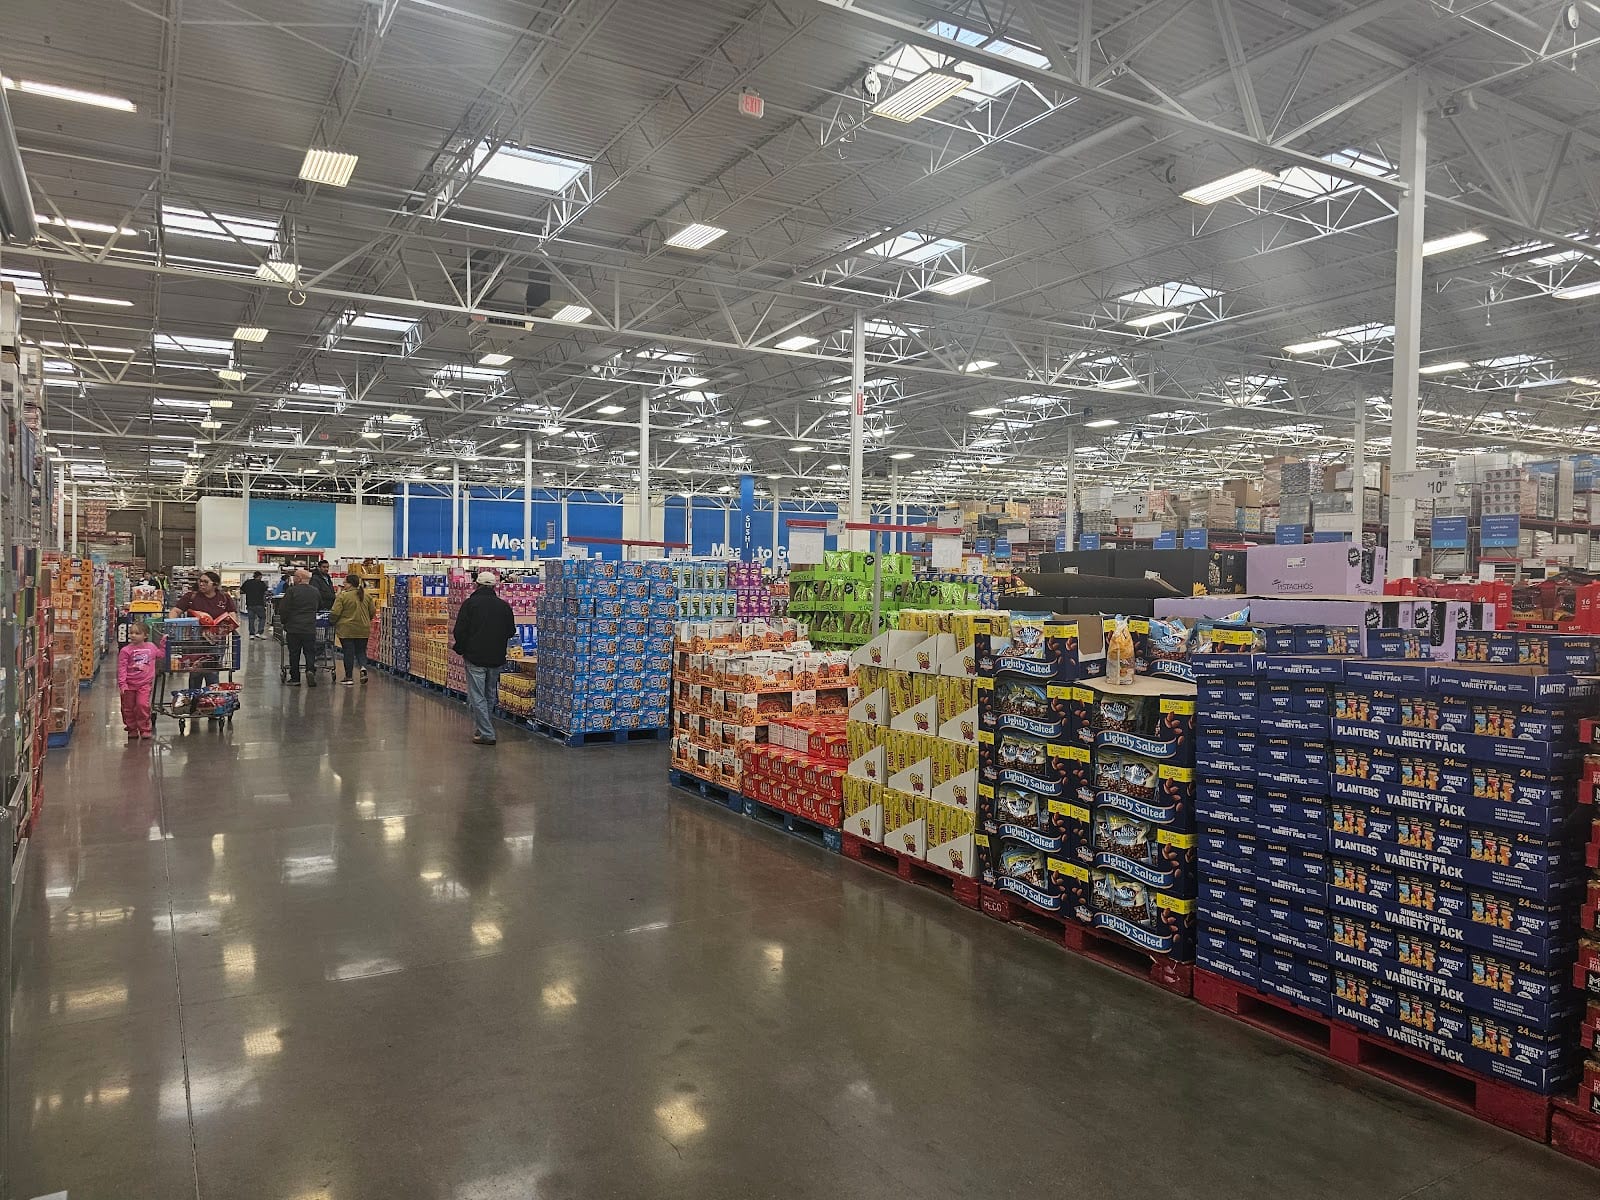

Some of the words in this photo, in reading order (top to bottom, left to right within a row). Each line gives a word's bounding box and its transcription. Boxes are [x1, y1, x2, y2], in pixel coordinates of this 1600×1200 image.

[266, 526, 317, 545] Dairy
[711, 542, 755, 559] Mea
[758, 546, 772, 559] to
[1000, 659, 1026, 673] Lightly
[1026, 662, 1051, 674] Salted
[1157, 661, 1186, 676] Lightly
[1284, 666, 1305, 674] VARIETY
[1460, 681, 1488, 690] VARIETY
[1488, 684, 1507, 692] PACK
[1540, 684, 1566, 695] PLANTERS
[1373, 690, 1383, 698] 24
[1443, 696, 1454, 704] 24
[1372, 705, 1395, 713] VARIETY
[1520, 704, 1533, 713] 24
[1442, 712, 1467, 720] VARIETY
[1003, 715, 1029, 731] Lightly
[1029, 721, 1054, 734] Salted
[1519, 721, 1547, 730] VARIETY
[1337, 725, 1380, 740] PLANTERS
[1402, 729, 1449, 742] SINGLE-SERVE
[1524, 727, 1542, 735] PACK
[1103, 732, 1135, 748] Lightly
[1136, 740, 1168, 754] Salted
[1386, 735, 1432, 750] VARIETY
[1435, 740, 1466, 754] PACK
[1373, 748, 1383, 756] 24
[1372, 763, 1395, 772] VARIETY
[1443, 758, 1454, 766] 24
[1376, 768, 1391, 776] PACK
[1519, 768, 1532, 778] 24
[1004, 770, 1030, 786] Lightly
[1030, 777, 1055, 793] Salted
[1442, 774, 1468, 783] VARIETY
[1336, 782, 1380, 799] PLANTERS
[1401, 789, 1449, 803] SINGLE-SERVE
[1518, 786, 1547, 796] VARIETY
[1523, 792, 1541, 800] PACK
[1103, 792, 1134, 813] Lightly
[1135, 803, 1166, 819] Salted
[1370, 806, 1380, 814] 24
[1386, 793, 1432, 812] VARIETY
[1434, 802, 1466, 817] PACK
[1369, 821, 1392, 830] VARIETY
[1439, 818, 1450, 827] 24
[1004, 824, 1030, 841] Lightly
[1029, 832, 1054, 849] Salted
[1438, 835, 1463, 844] VARIETY
[1517, 833, 1529, 843] 24
[1335, 838, 1378, 857] PLANTERS
[1442, 841, 1458, 849] PACK
[1399, 848, 1446, 864] SINGLE-SERVE
[1516, 850, 1544, 861] VARIETY
[1520, 857, 1538, 865] PACK
[1102, 853, 1134, 874] Lightly
[1134, 866, 1165, 884] Salted
[1370, 863, 1380, 872] 24
[1383, 852, 1429, 872] VARIETY
[1432, 863, 1463, 879] PACK
[1369, 878, 1393, 889] VARIETY
[1373, 884, 1388, 892] PACK
[1439, 879, 1450, 889] 24
[1003, 877, 1028, 896] Lightly
[1028, 888, 1054, 907] Salted
[984, 900, 1002, 911] PECO
[1335, 894, 1379, 915] PLANTERS
[1438, 896, 1464, 907] VARIETY
[1443, 902, 1459, 910] PACK
[1518, 897, 1530, 907] 24
[1530, 903, 1545, 911] COUNT
[1400, 907, 1447, 926] SINGLE-SERVE
[1517, 915, 1545, 926] VARIETY
[1101, 913, 1132, 935] Lightly
[1132, 929, 1163, 948] Salted
[1370, 921, 1380, 929] 24
[1384, 910, 1430, 932] VARIETY
[1432, 922, 1464, 940] PACK
[1521, 921, 1540, 930] PACK
[1369, 936, 1392, 946] VARIETY
[1373, 942, 1388, 950] PACK
[1439, 940, 1450, 950] 24
[1335, 950, 1379, 973] PLANTERS
[1439, 956, 1464, 968] VARIETY
[1443, 963, 1459, 972] PACK
[1519, 961, 1531, 972] 24
[1531, 968, 1546, 976] COUNT
[1372, 978, 1382, 986] 24
[1400, 967, 1447, 987] SINGLE-SERVE
[1385, 969, 1431, 992] VARIETY
[1433, 983, 1464, 1003] PACK
[1517, 978, 1546, 991] VARIETY
[1522, 985, 1541, 995] PACK
[1371, 992, 1394, 1004] VARIETY
[1375, 999, 1389, 1008] PACK
[1439, 1000, 1450, 1010] 24
[1337, 1004, 1380, 1029] PLANTERS
[1439, 1016, 1464, 1029] VARIETY
[1443, 1023, 1459, 1032] PACK
[1400, 1025, 1446, 1047] SINGLE-SERVE
[1517, 1025, 1529, 1035] 24
[1529, 1032, 1544, 1041] COUNT
[1385, 1026, 1431, 1051] VARIETY
[1433, 1044, 1464, 1063] PACK
[1516, 1042, 1544, 1056] VARIETY
[1521, 1049, 1539, 1060] PACK
